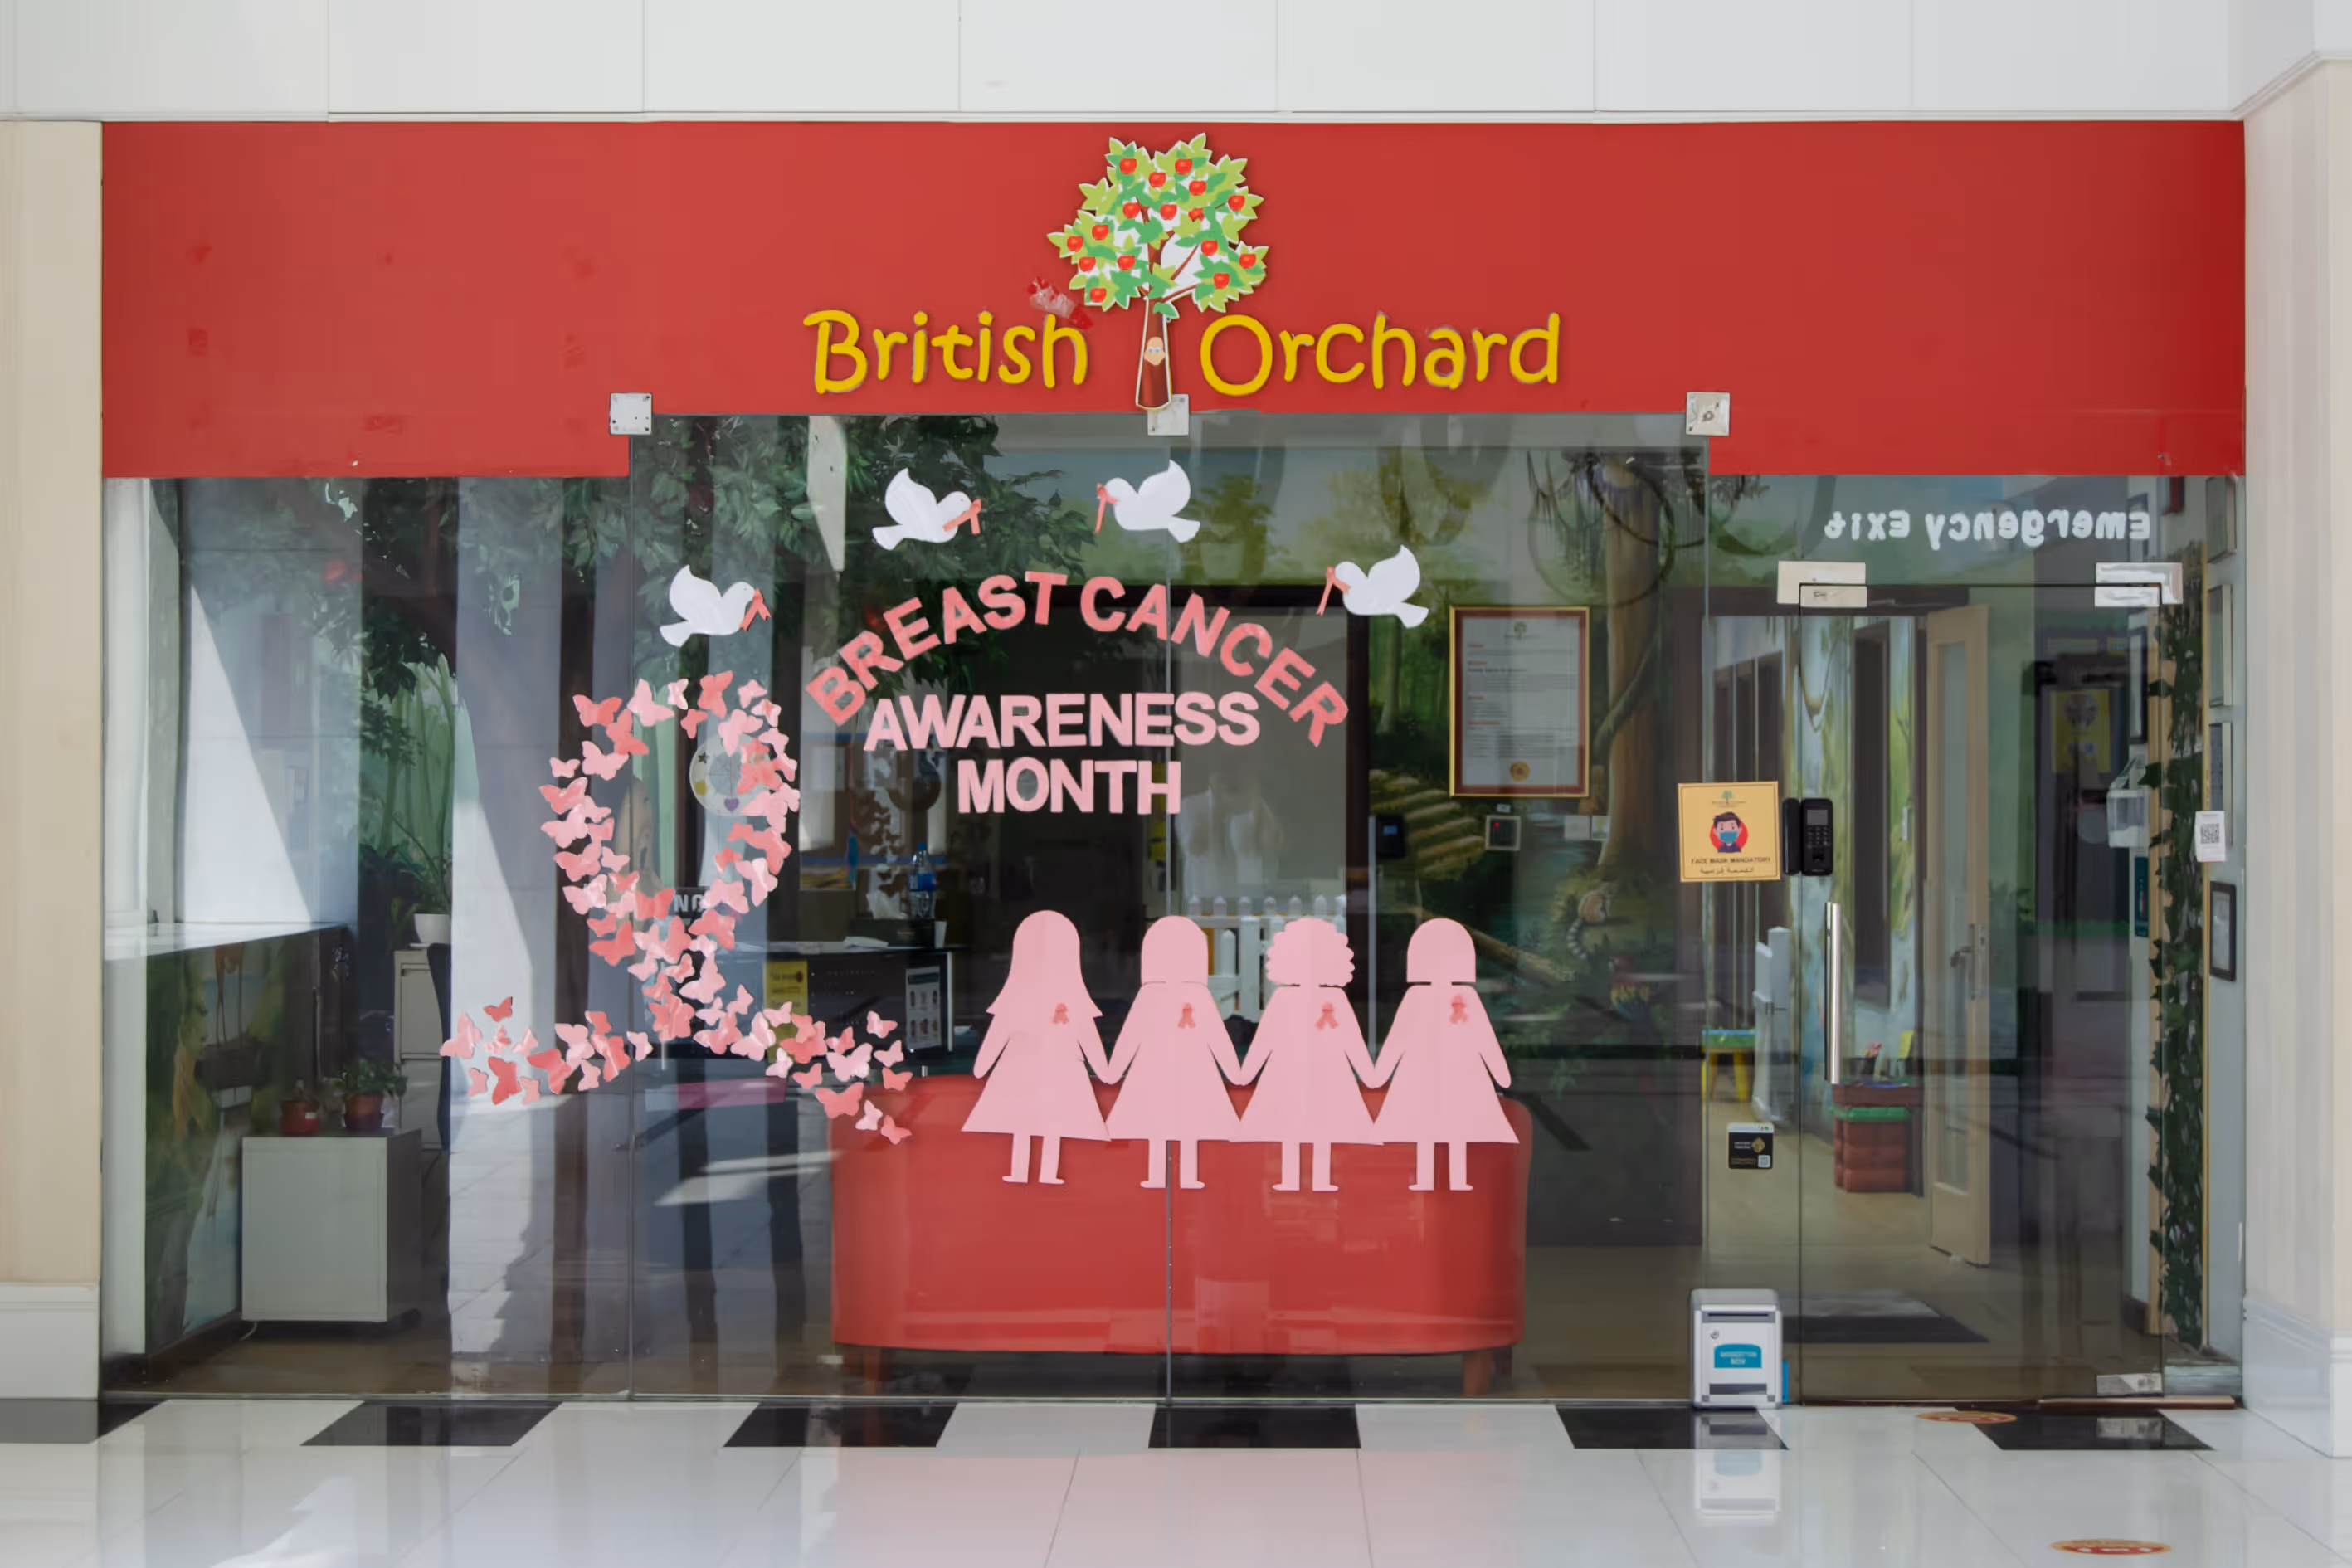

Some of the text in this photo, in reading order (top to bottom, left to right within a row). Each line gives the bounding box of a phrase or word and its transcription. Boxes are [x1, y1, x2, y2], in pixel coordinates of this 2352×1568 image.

[802, 309, 1561, 397] British Orchard
[805, 570, 1350, 747] BREAST CANCER
[863, 691, 1261, 752] AWARENESS
[957, 757, 1181, 815] MONTH
